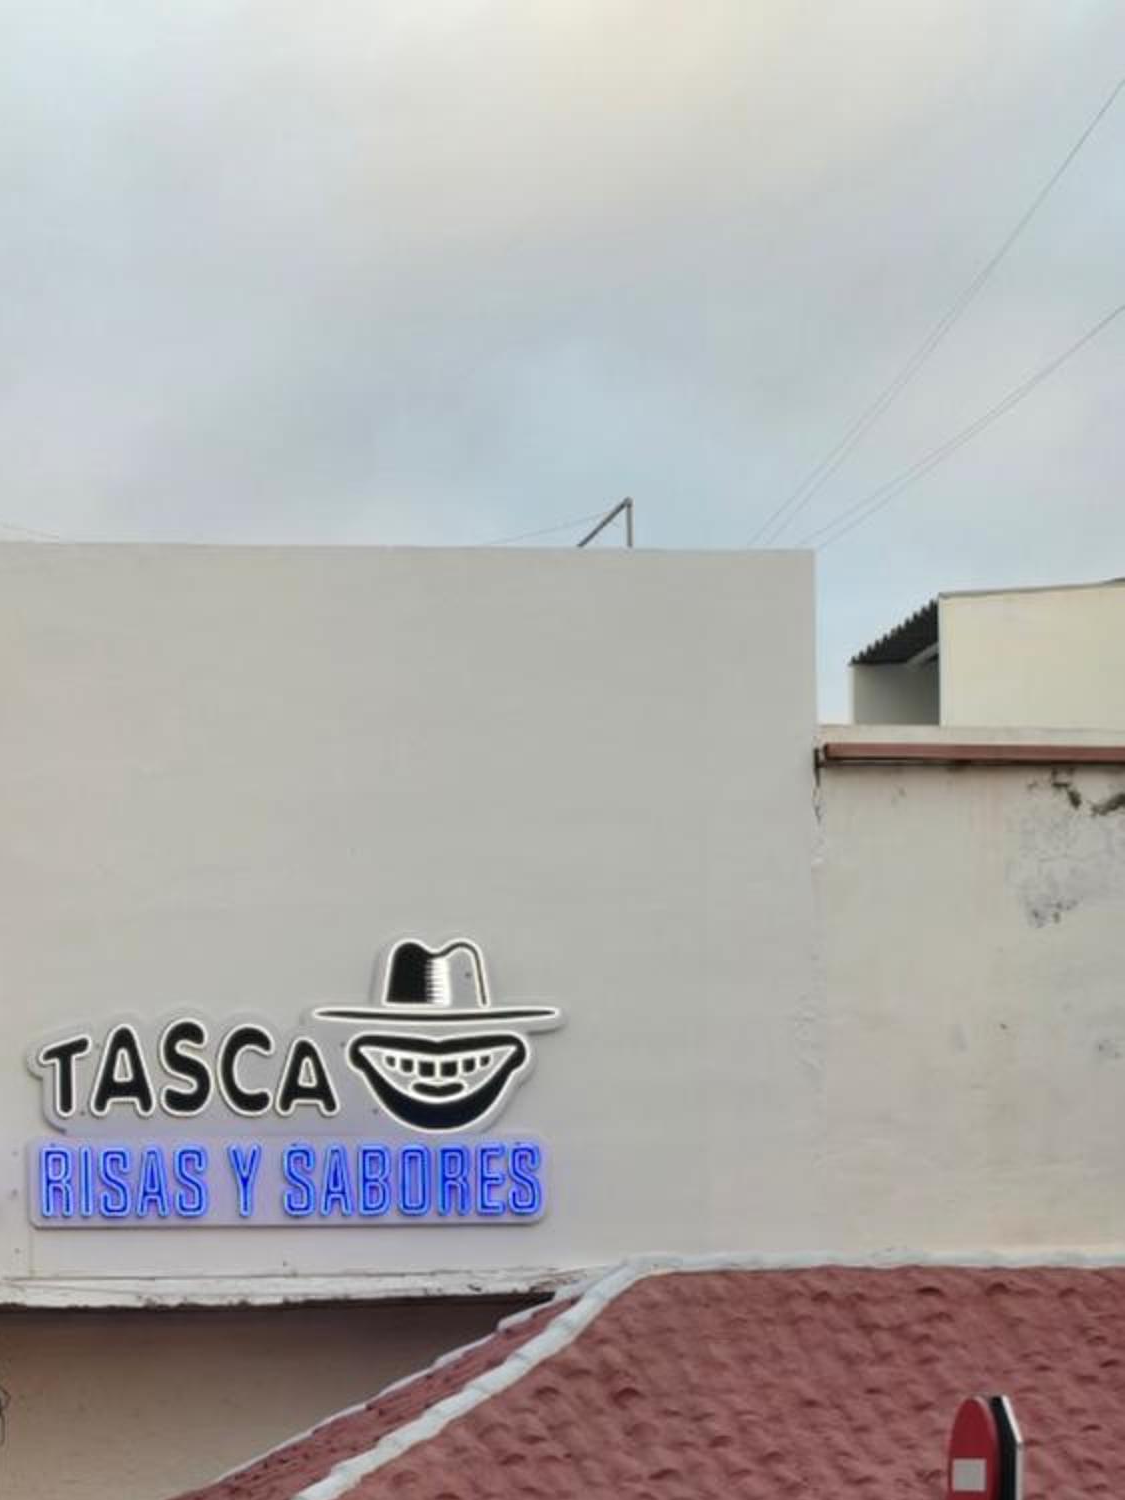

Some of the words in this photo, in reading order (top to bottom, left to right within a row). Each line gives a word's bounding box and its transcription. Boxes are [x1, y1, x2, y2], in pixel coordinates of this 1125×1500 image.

[40, 1020, 340, 1117] TASCA
[39, 1144, 209, 1217] RISAS
[227, 1143, 263, 1217] Y
[281, 1142, 542, 1217] SABORES
